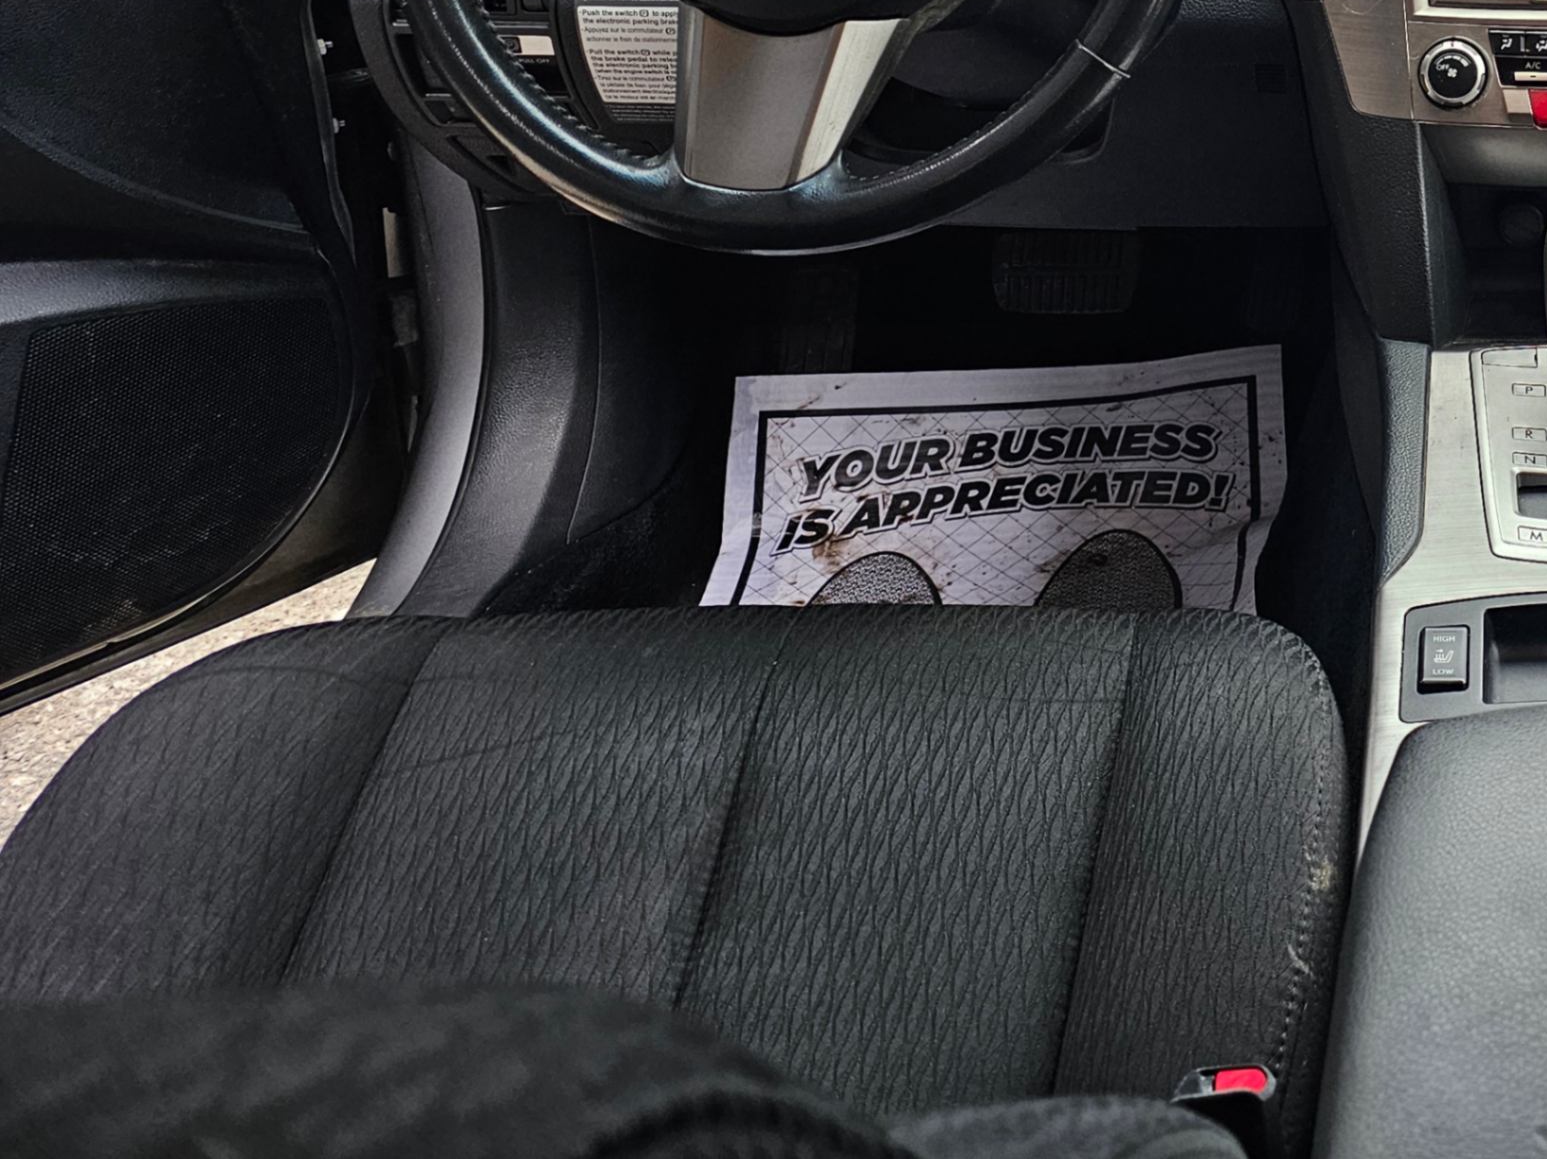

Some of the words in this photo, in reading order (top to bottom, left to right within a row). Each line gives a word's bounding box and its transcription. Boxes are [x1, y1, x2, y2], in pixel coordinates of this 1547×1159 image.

[1436, 64, 1449, 72] OFF
[1525, 62, 1541, 70] A/C
[1525, 386, 1533, 394] P
[1525, 430, 1533, 438] R
[800, 435, 955, 502] YOUR
[960, 422, 1222, 468] BUSINESS
[1524, 456, 1536, 464] N
[771, 508, 836, 555] IS
[842, 471, 1236, 538] APPRECIATED!
[1530, 532, 1543, 541] M
